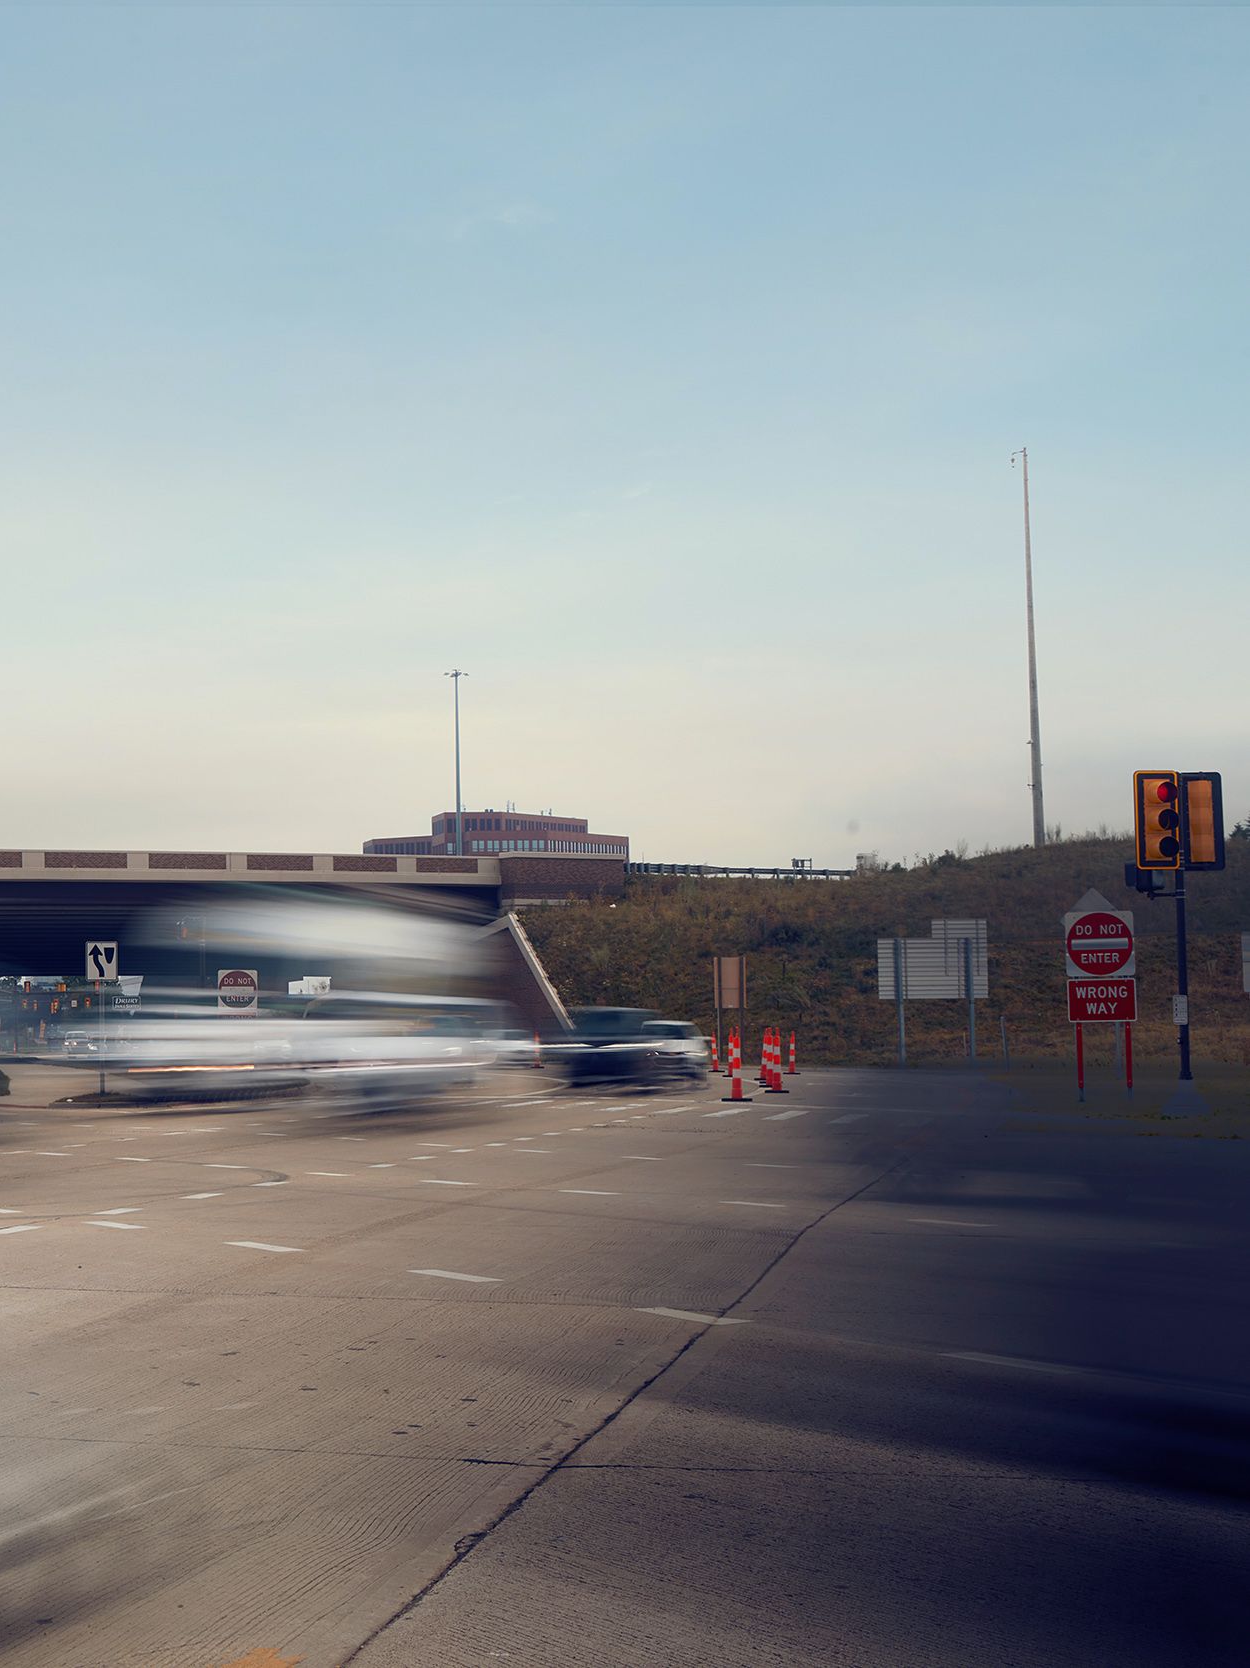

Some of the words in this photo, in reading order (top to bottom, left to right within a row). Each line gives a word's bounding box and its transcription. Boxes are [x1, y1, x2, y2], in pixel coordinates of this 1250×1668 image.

[1075, 925, 1093, 936] DO
[1100, 924, 1124, 935] NOT
[1081, 953, 1120, 964] ENTER
[223, 977, 234, 985] DO
[237, 977, 252, 985] NOT
[1075, 986, 1128, 999] WRONG
[1086, 1002, 1118, 1015] WAY
